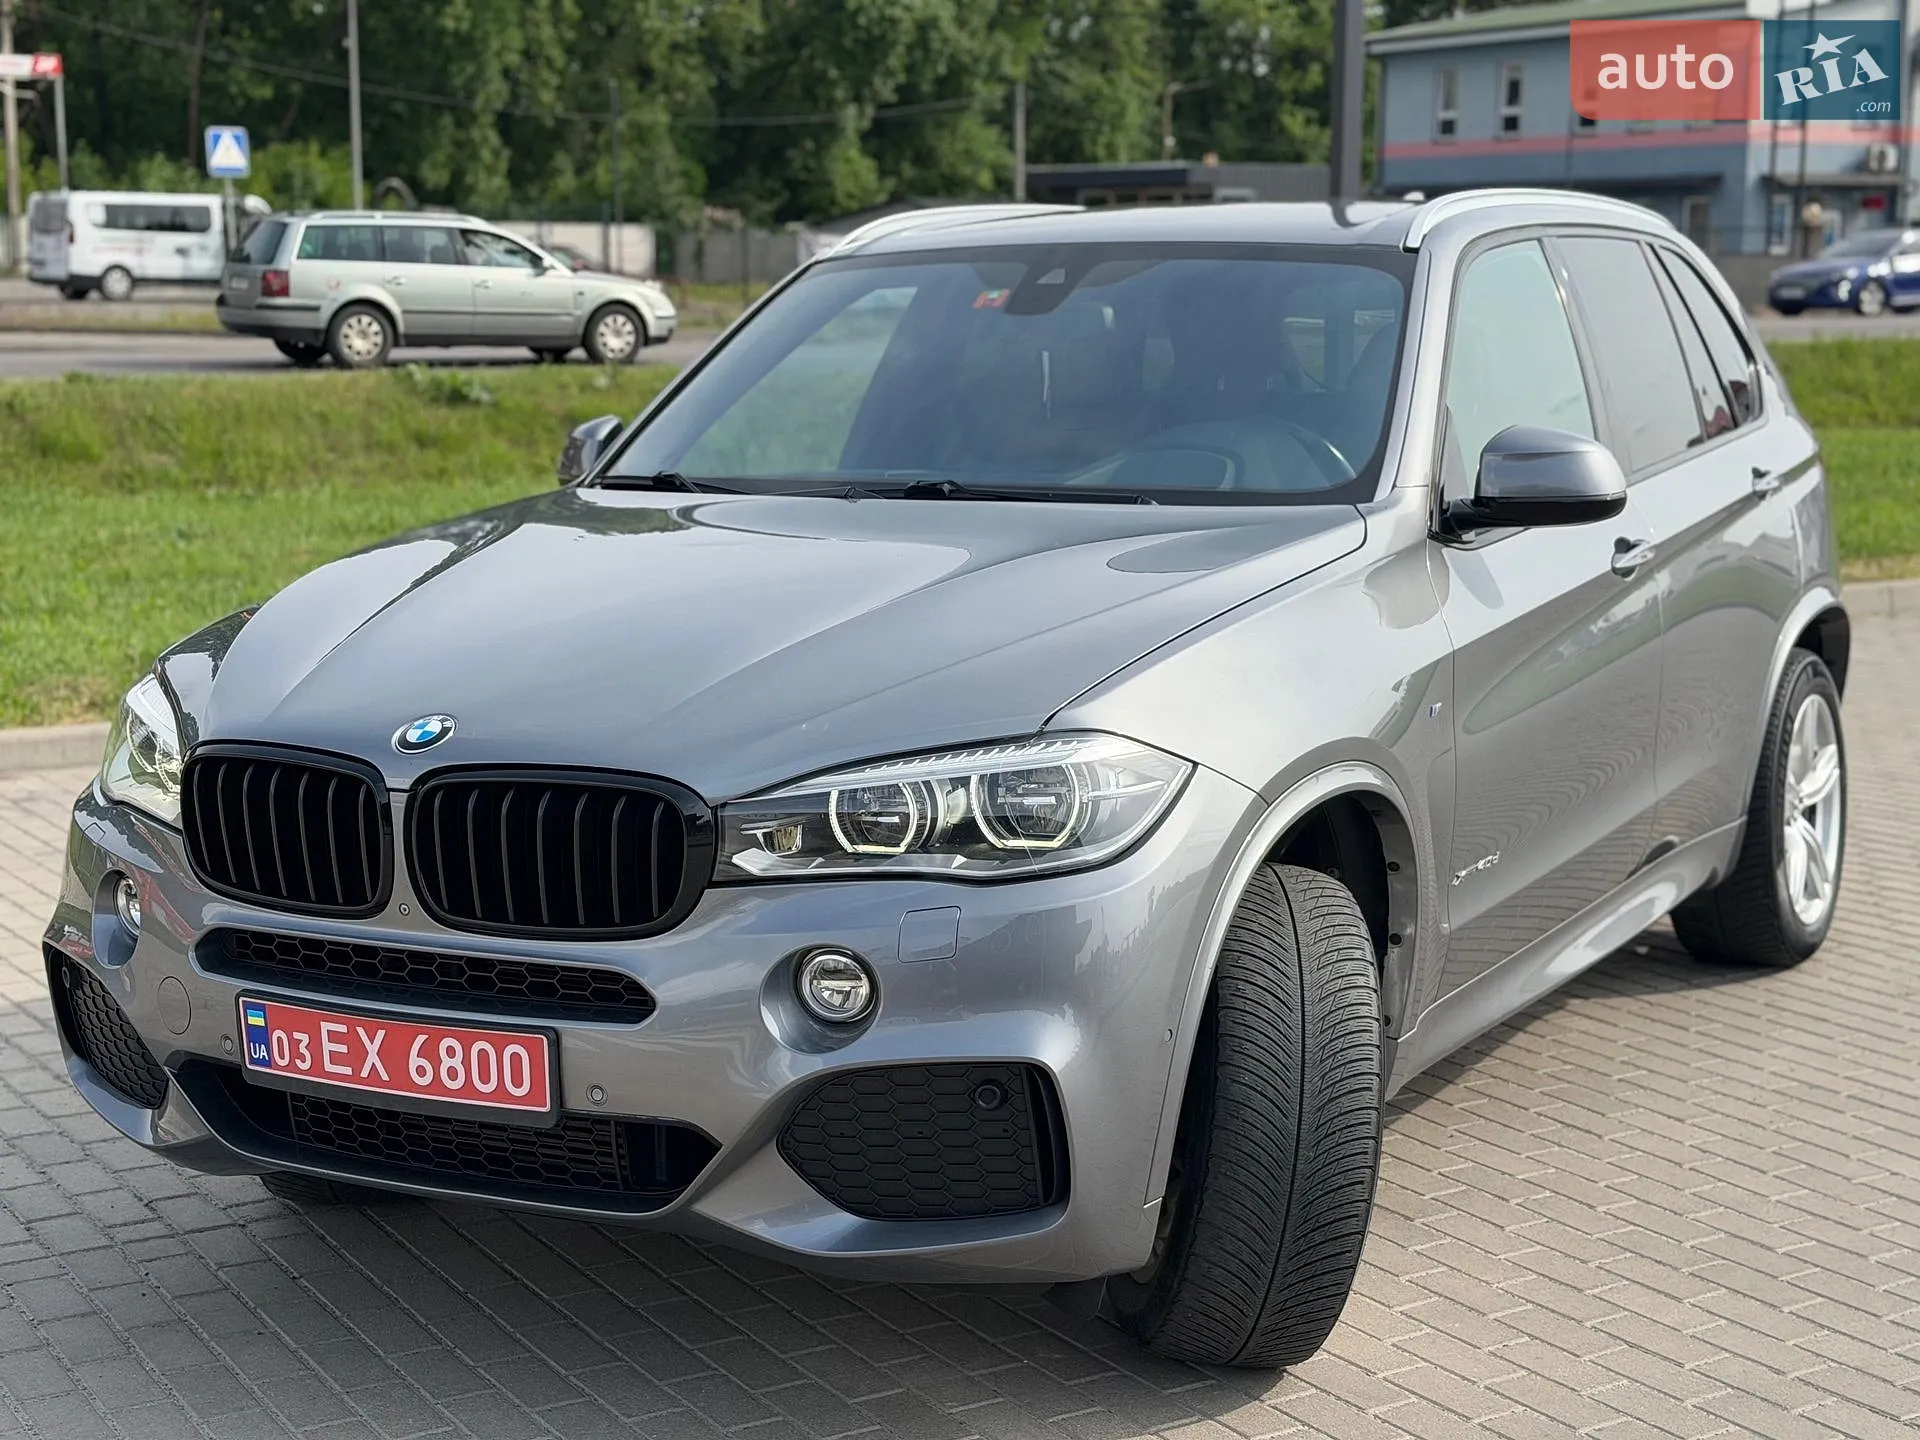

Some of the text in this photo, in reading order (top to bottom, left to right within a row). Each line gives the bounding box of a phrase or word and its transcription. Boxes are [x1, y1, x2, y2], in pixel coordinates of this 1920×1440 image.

[250, 1042, 269, 1060] UA
[271, 1021, 531, 1097] 03 EX 6800
